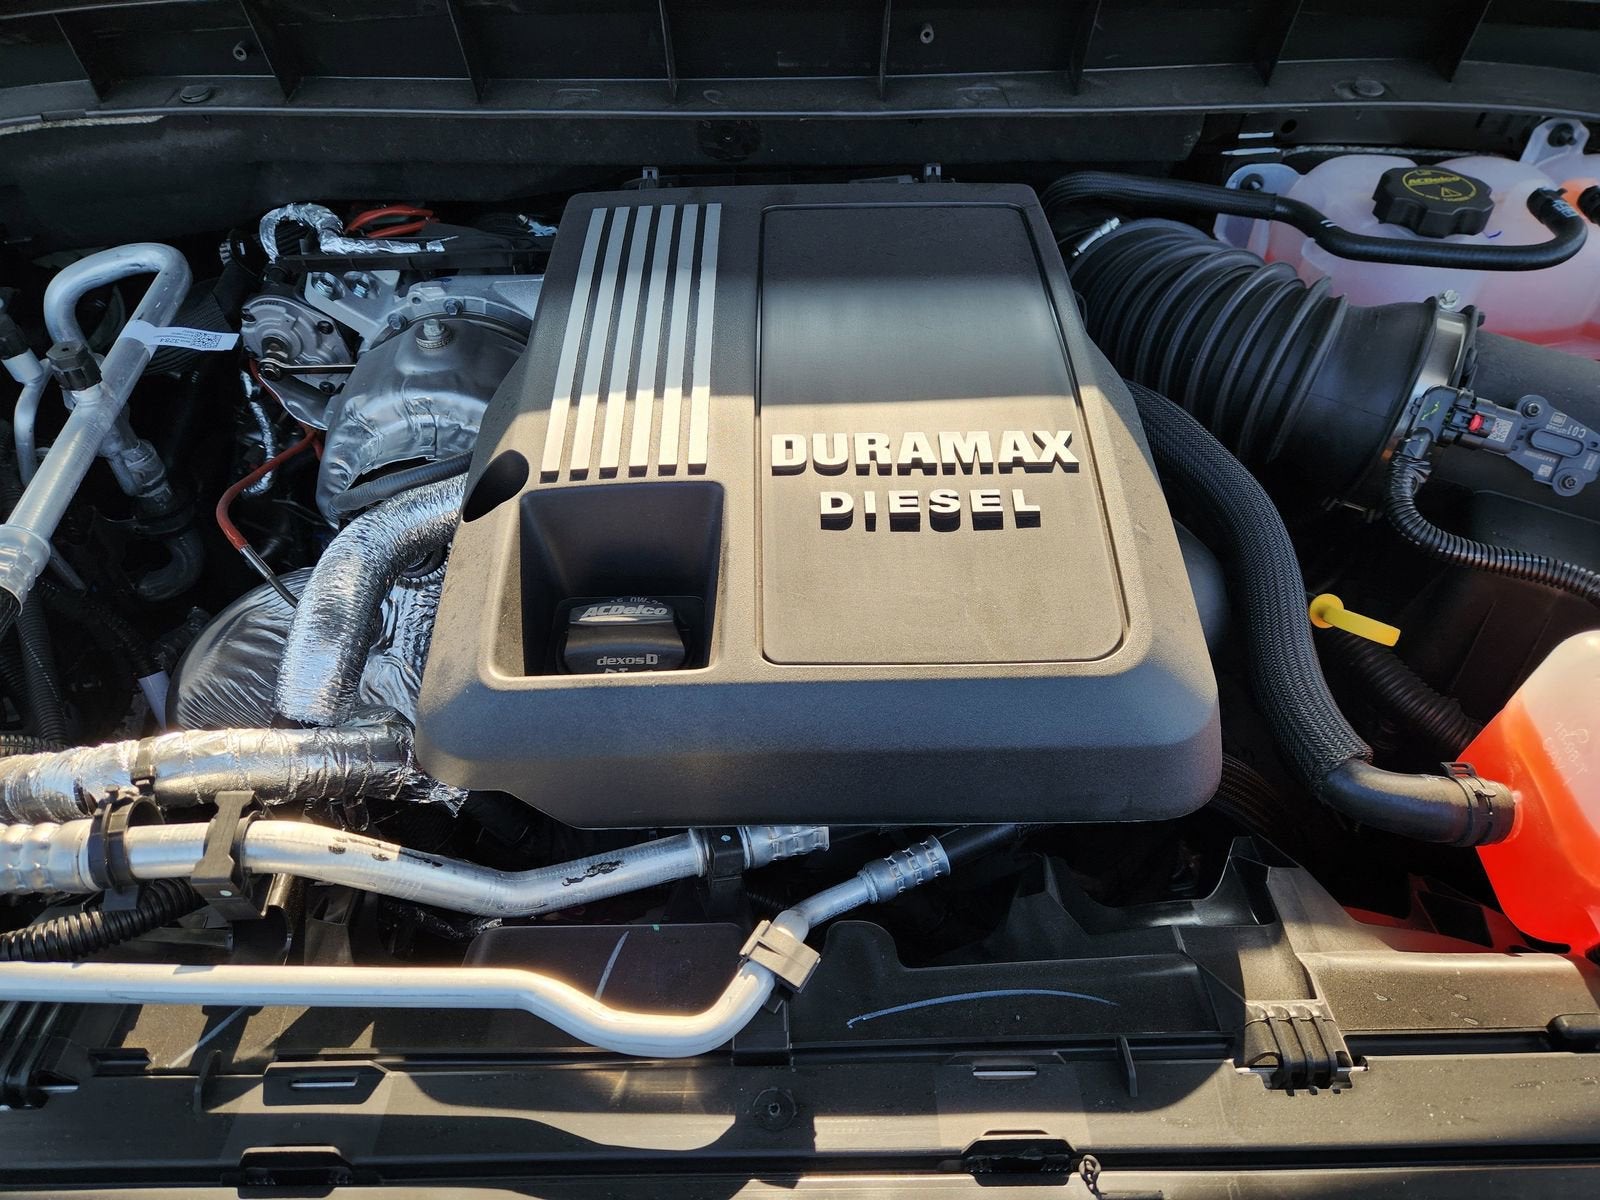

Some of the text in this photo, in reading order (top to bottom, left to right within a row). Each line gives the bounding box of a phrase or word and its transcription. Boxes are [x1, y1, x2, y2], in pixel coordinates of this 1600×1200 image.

[771, 430, 1080, 475] DURAMAX
[819, 488, 1042, 529] DIESEL
[581, 604, 668, 618] ACDelco
